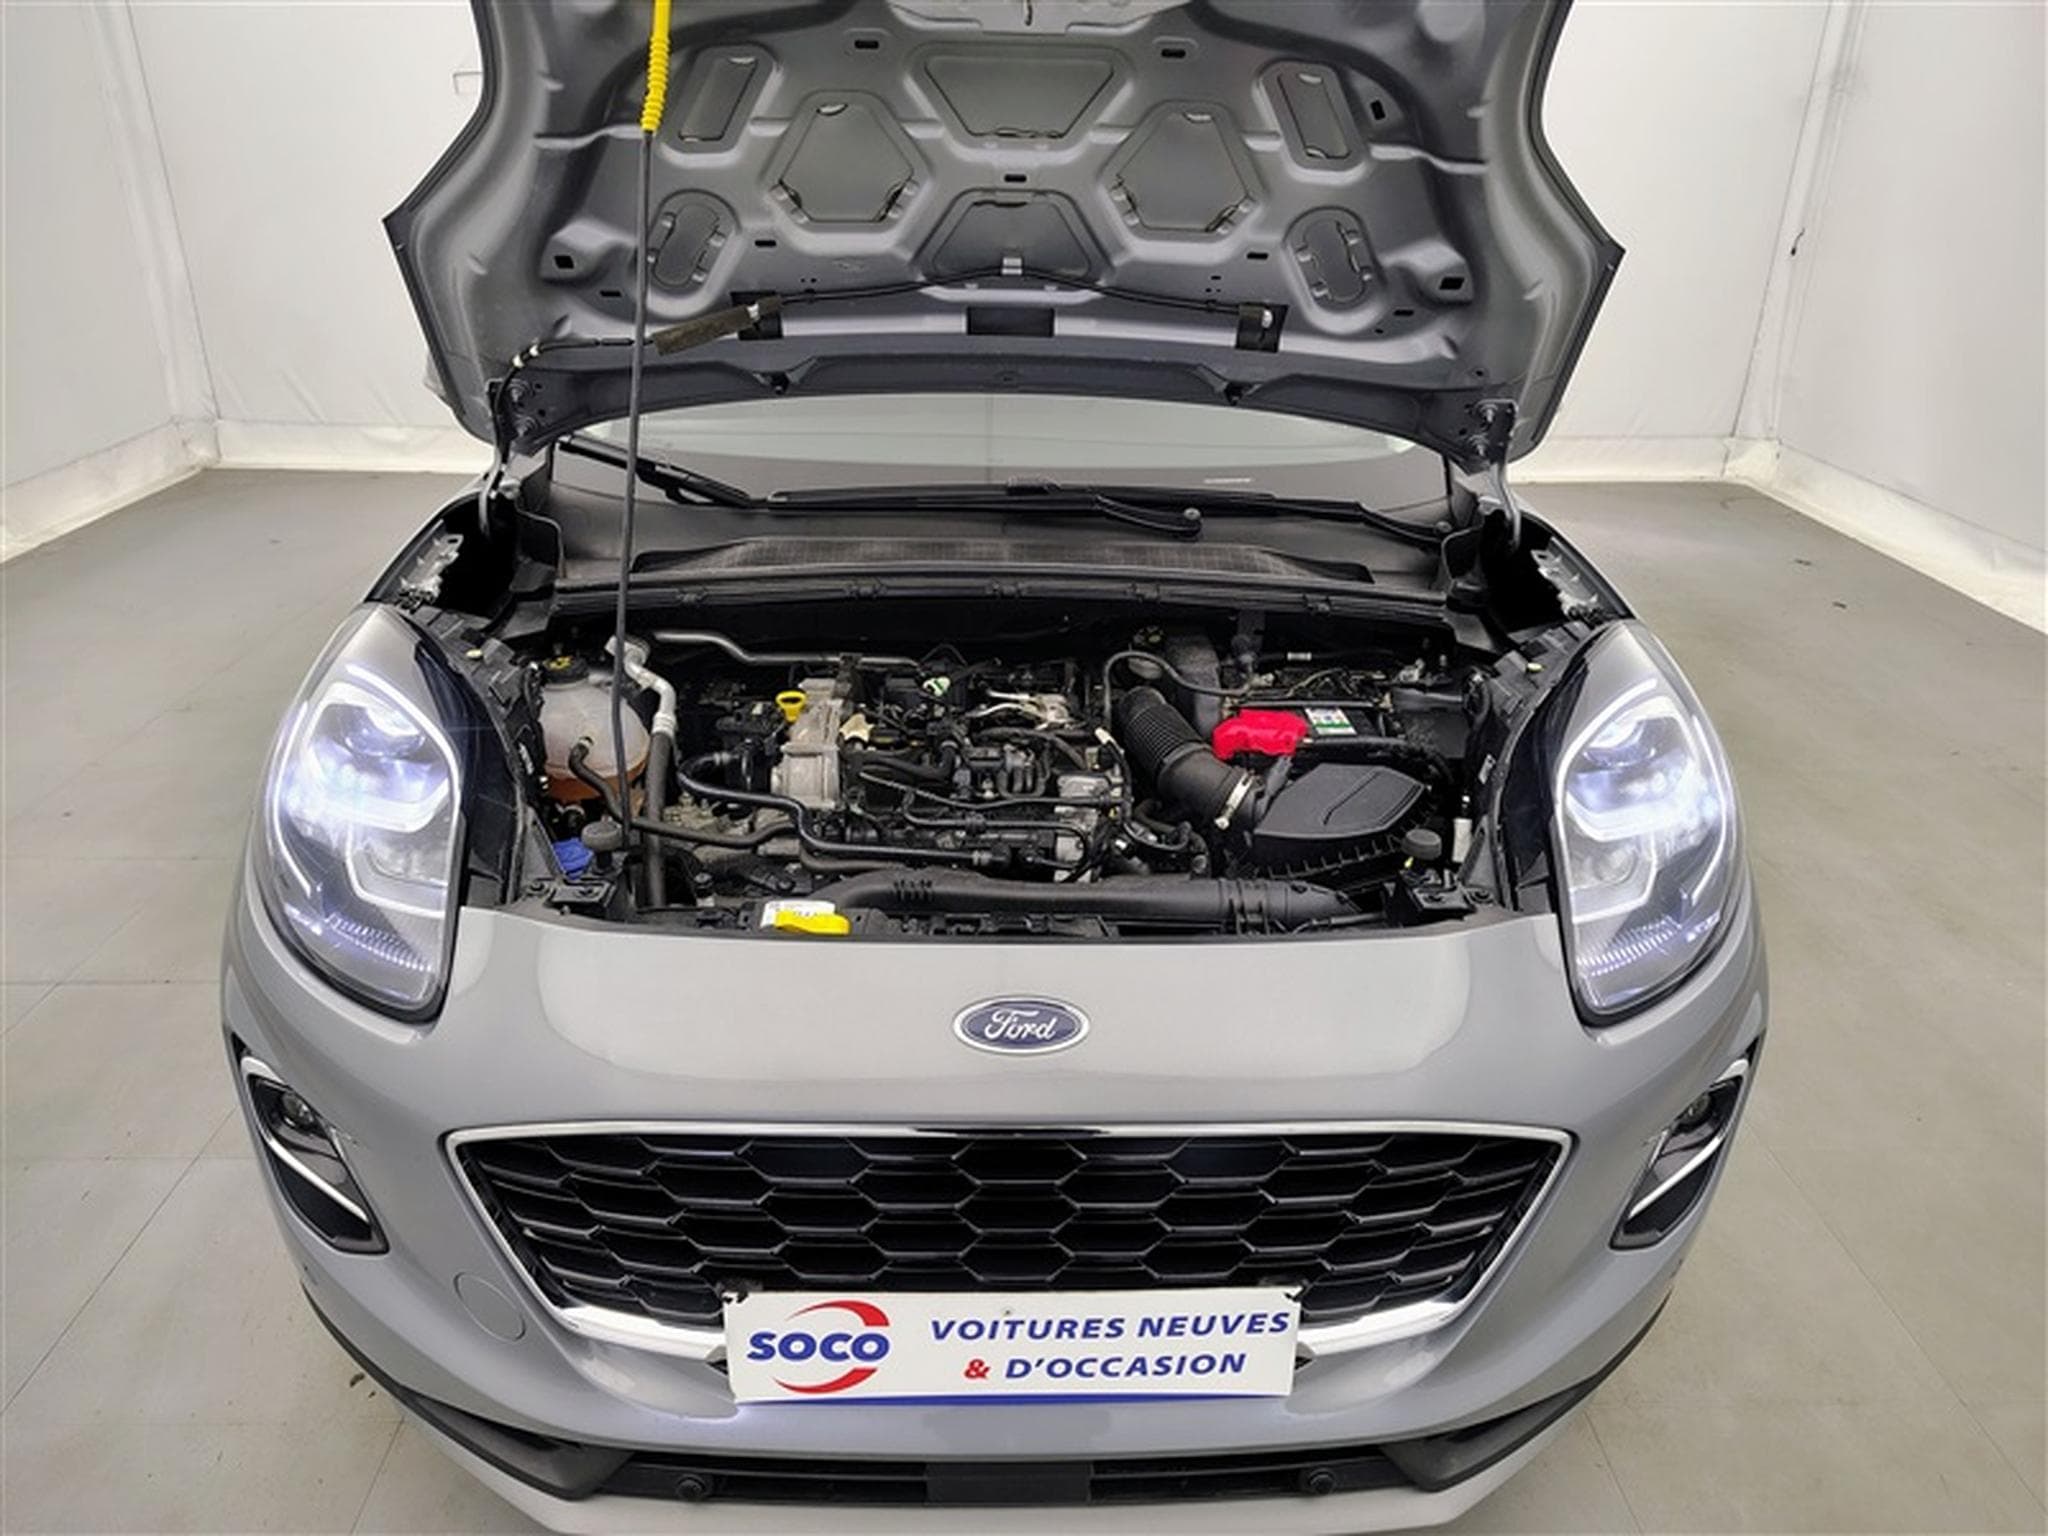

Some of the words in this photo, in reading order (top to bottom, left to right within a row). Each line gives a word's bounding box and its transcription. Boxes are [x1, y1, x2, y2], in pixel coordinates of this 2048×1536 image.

[983, 1009, 1058, 1039] Ford
[930, 1318, 1125, 1341] VOITURES
[1138, 1311, 1290, 1338] NEUVES
[747, 1331, 891, 1363] SOCO
[963, 1359, 991, 1380] &
[1005, 1353, 1247, 1379] D'OCCASION
